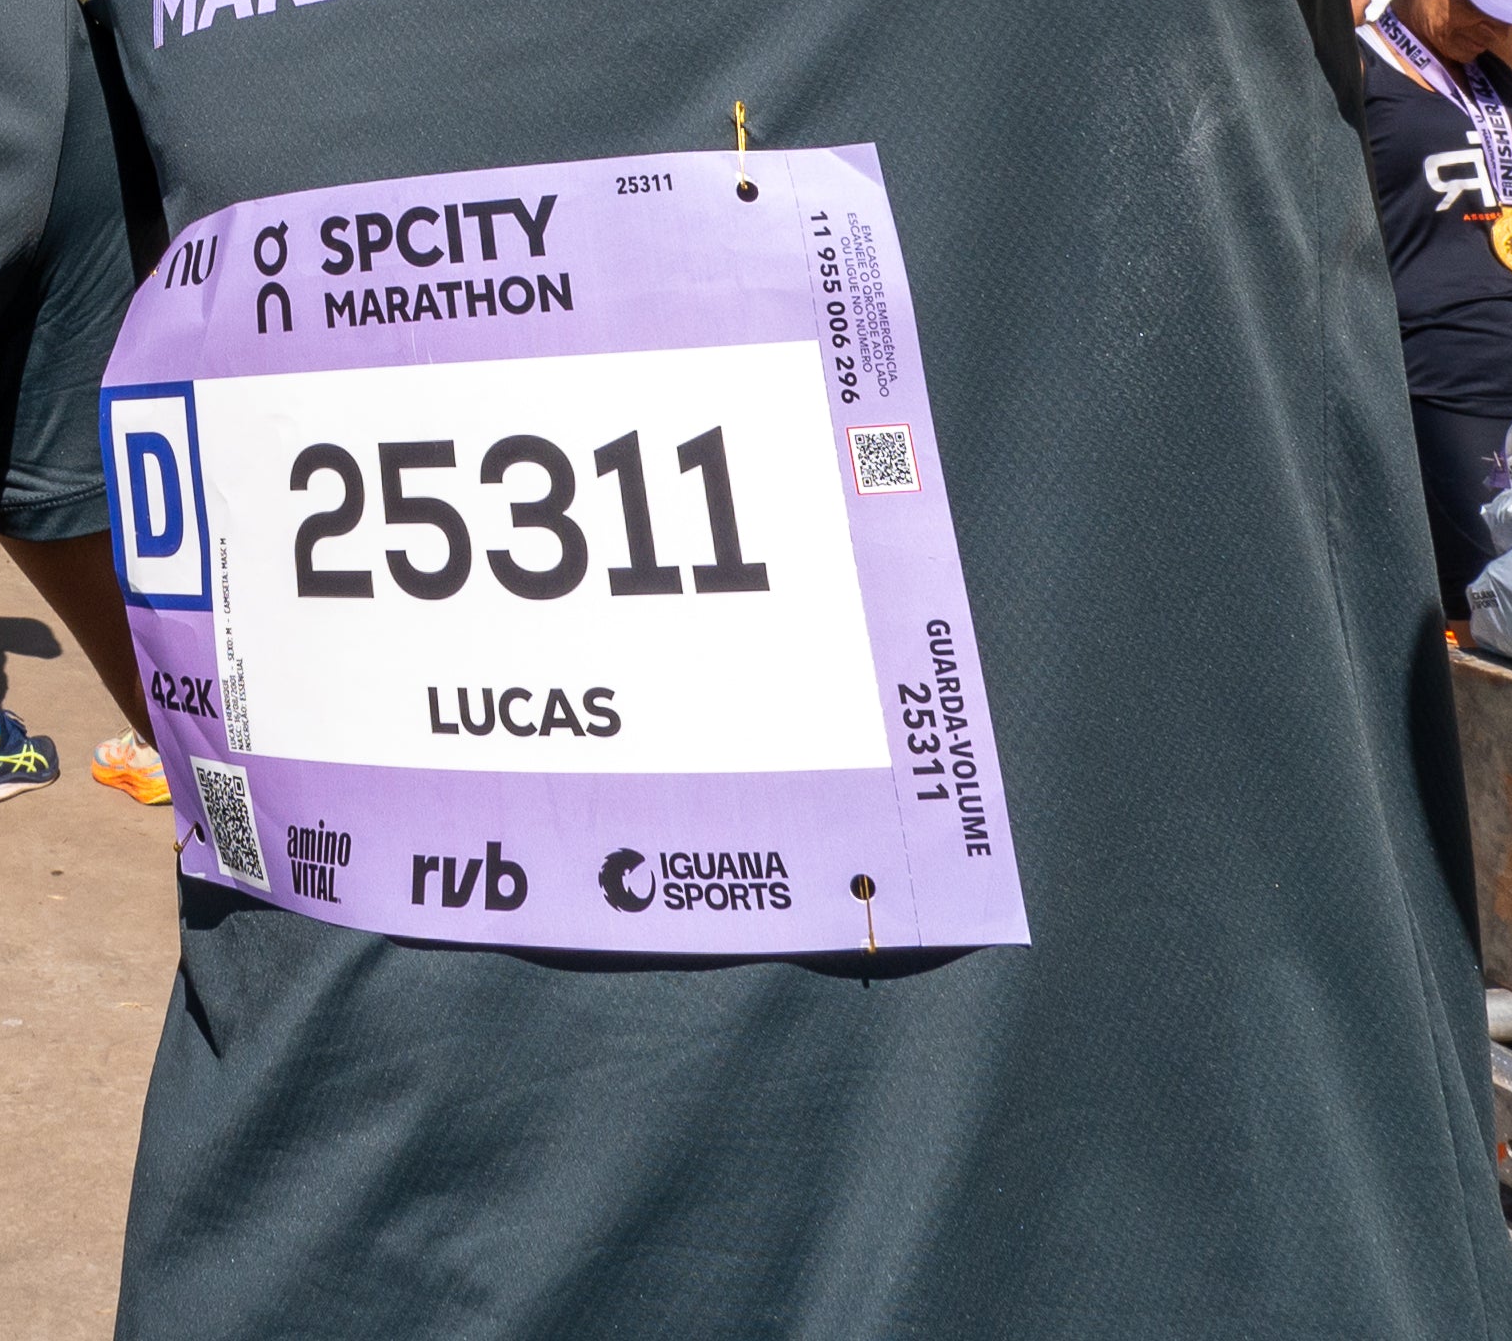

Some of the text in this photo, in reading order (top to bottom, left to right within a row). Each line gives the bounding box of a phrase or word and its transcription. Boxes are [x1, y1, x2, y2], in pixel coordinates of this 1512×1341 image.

[320, 195, 559, 275] SPCITY
[616, 173, 673, 195] 25311
[324, 272, 574, 329] MARATHON
[810, 210, 860, 404] 11 955 006 296
[840, 236, 873, 373] OU LIGUE NO NÚMERO
[847, 212, 889, 398] ESCANEIE O QRCODE AO LADO
[861, 225, 898, 383] EM CASO DE EMERGÊNCIA
[124, 431, 181, 559] D
[288, 425, 771, 602] 25311
[151, 670, 219, 719] 42.2K
[427, 686, 622, 738] LUCAS
[897, 682, 950, 801] 25311
[926, 619, 992, 857] GUARDA-VOLUME
[287, 819, 352, 868] amino
[291, 864, 341, 905] VITAL
[411, 840, 529, 912] rvb
[660, 850, 789, 880] IGUANA
[663, 881, 792, 911] SPORTS
